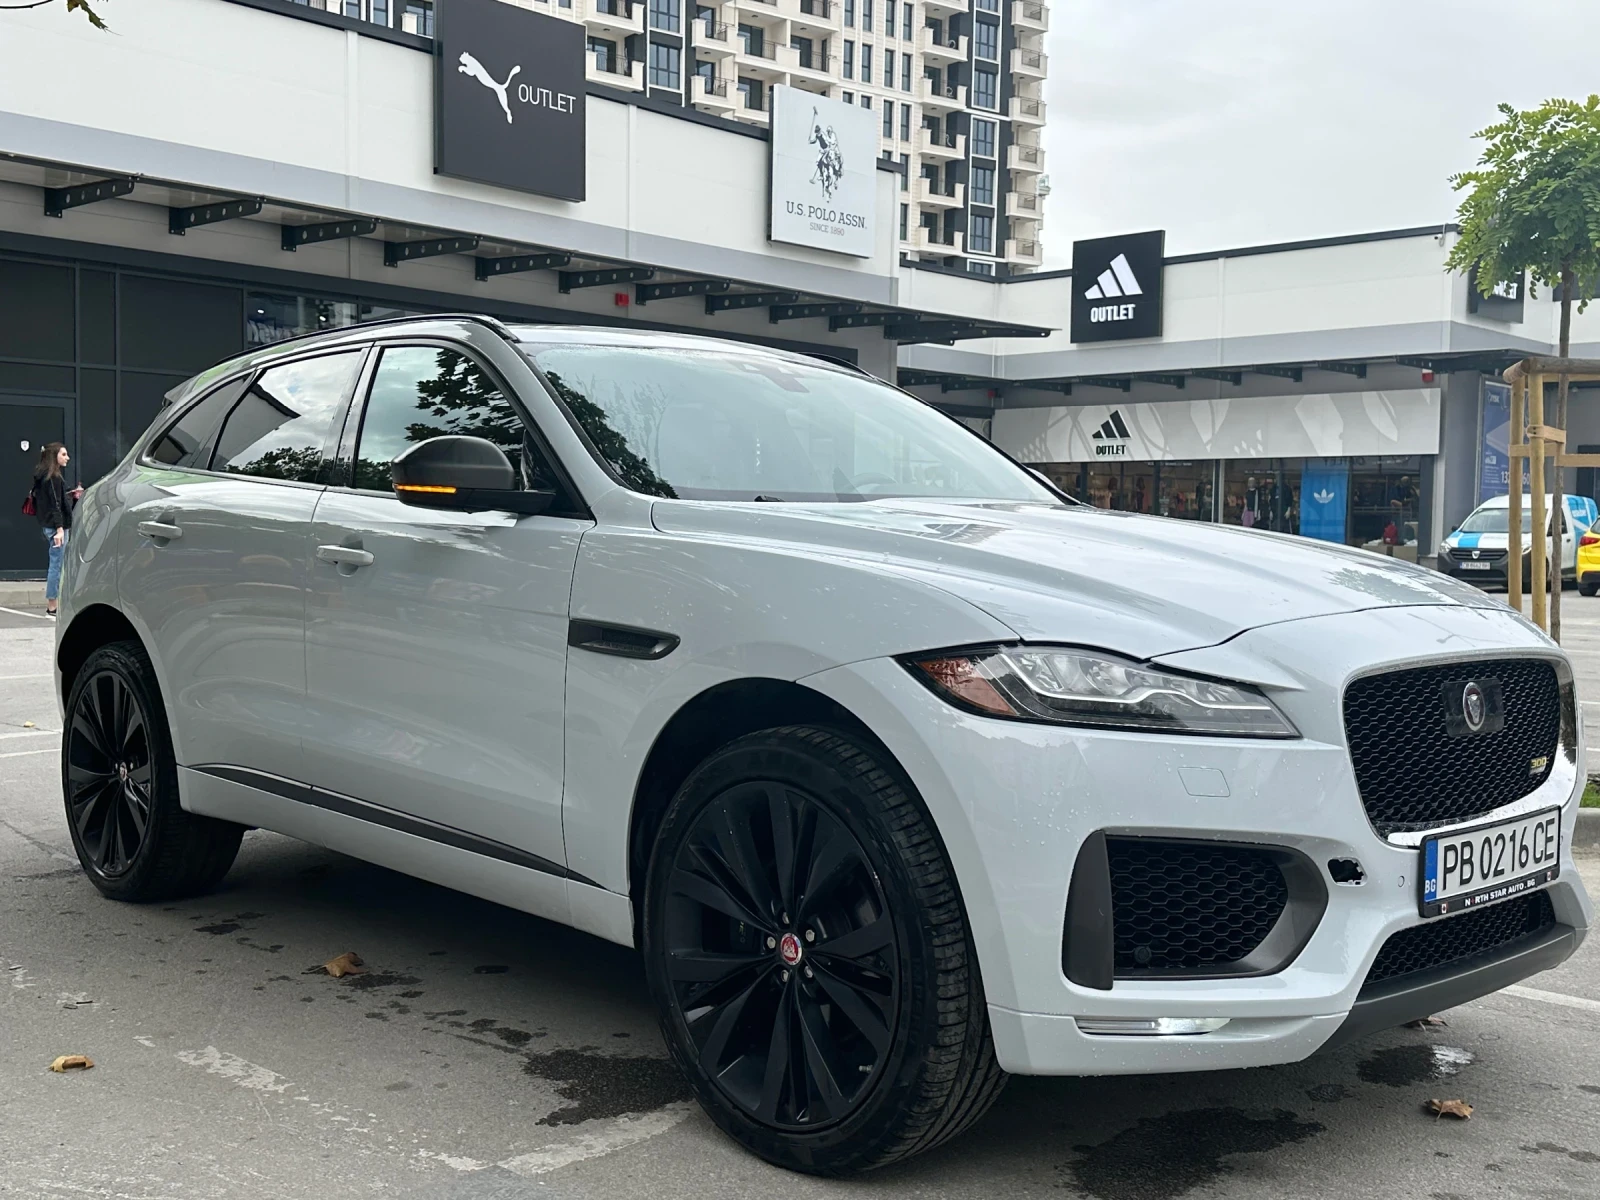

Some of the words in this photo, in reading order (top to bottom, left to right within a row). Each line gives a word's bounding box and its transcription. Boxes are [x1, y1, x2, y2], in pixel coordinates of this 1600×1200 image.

[518, 84, 577, 114] OUTLET
[786, 200, 806, 216] U.S.
[808, 205, 836, 222] POLO
[838, 212, 868, 229] ASSN.
[809, 222, 829, 233] SINCE
[830, 226, 845, 236] 1890
[1090, 303, 1136, 323] OUTLET
[1096, 445, 1126, 456] OUTLET
[1425, 879, 1437, 893] BG
[1443, 842, 1474, 890] PB
[1480, 826, 1529, 880] 0216
[1533, 818, 1555, 864] CE
[1489, 888, 1507, 900] STAR
